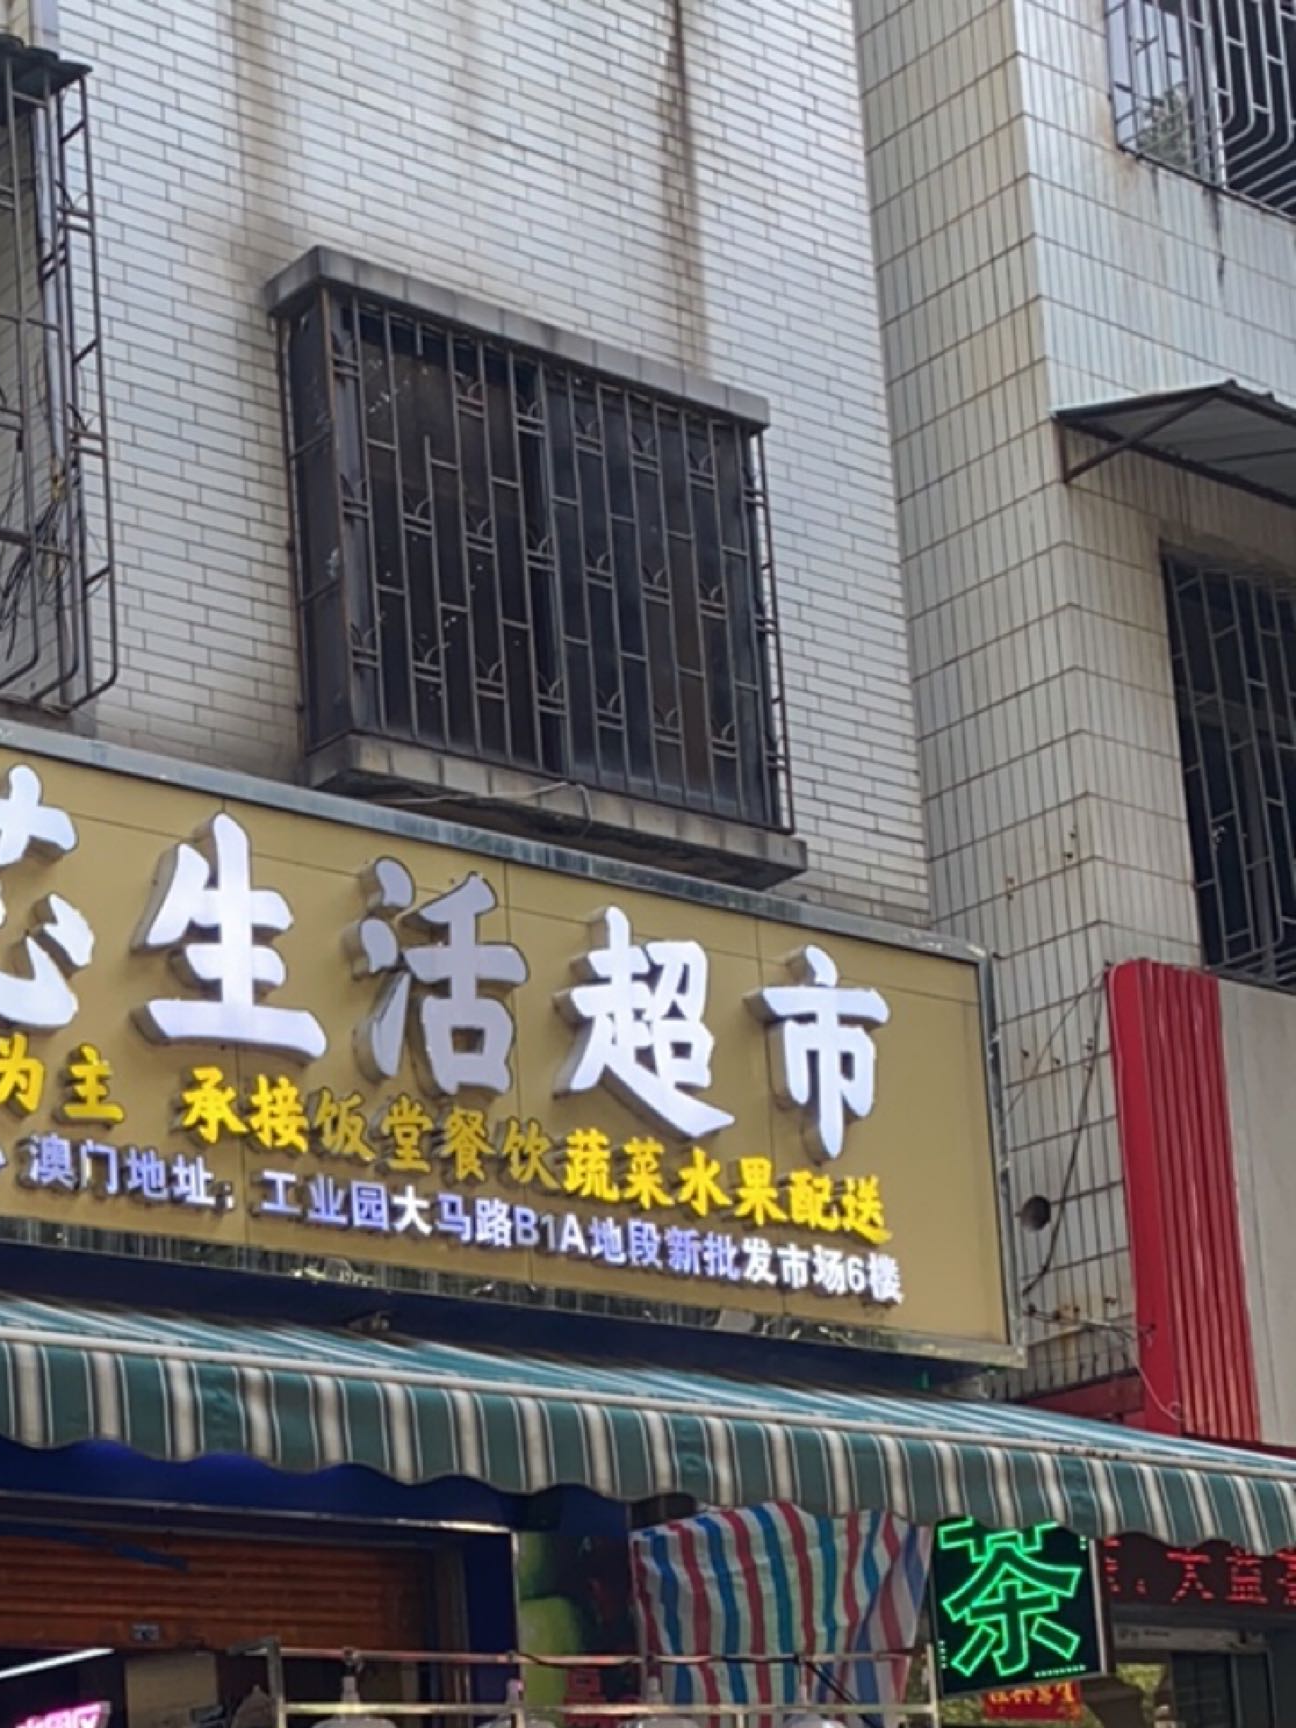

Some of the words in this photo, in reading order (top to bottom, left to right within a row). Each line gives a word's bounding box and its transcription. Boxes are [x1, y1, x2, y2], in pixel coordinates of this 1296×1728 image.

[181, 1066, 892, 1244] 承接饭堂餐饮蔬菜水果配送
[938, 1516, 1083, 1677] 茶
